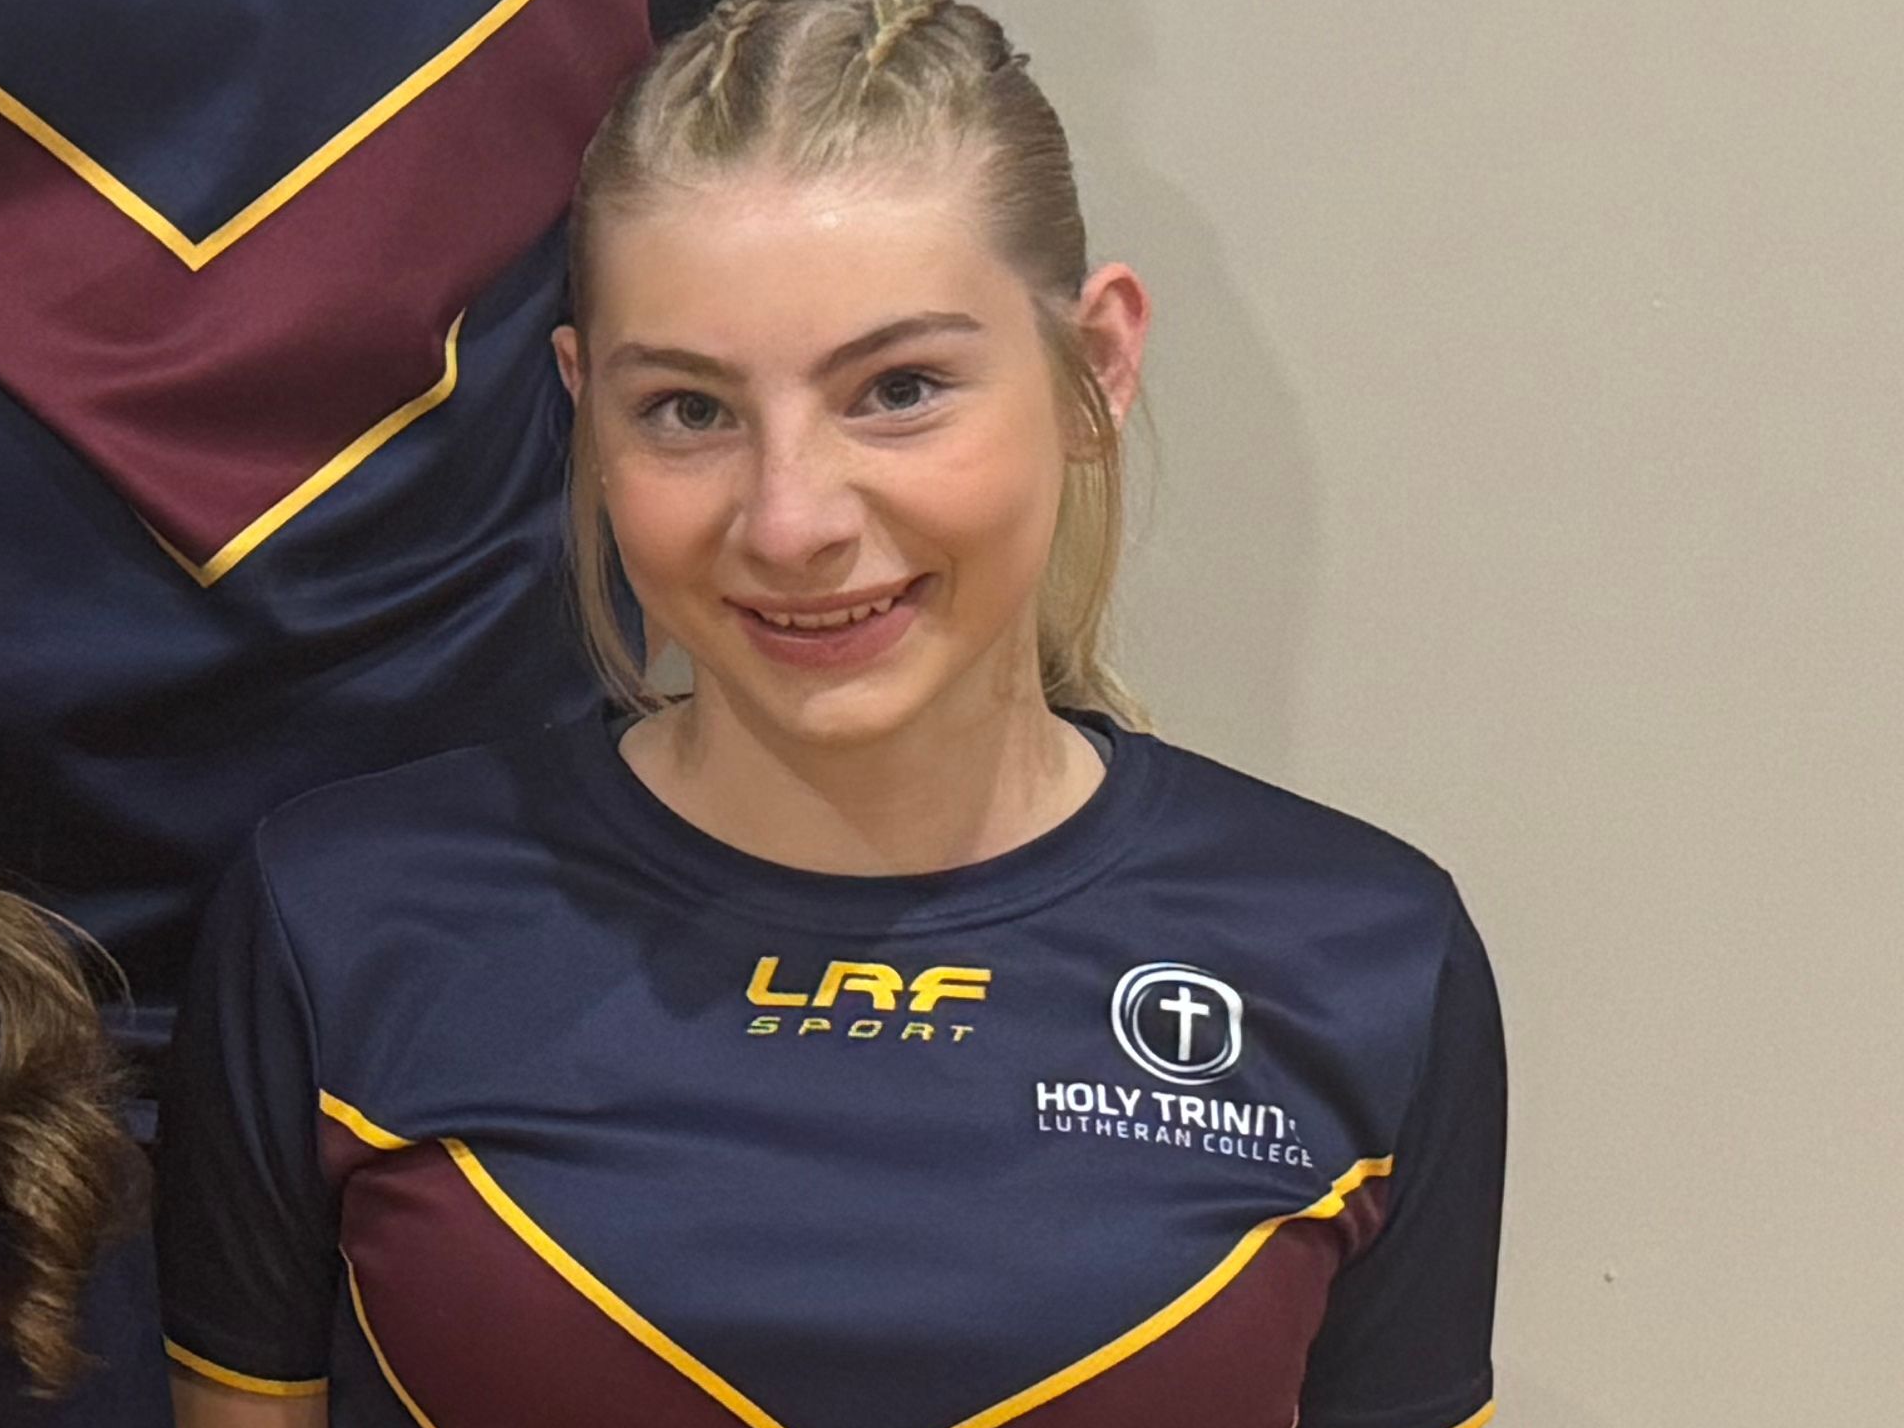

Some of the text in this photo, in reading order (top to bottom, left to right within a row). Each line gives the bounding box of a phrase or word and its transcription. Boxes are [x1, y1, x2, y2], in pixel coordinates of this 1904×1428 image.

[745, 956, 992, 1013] LRF
[745, 1015, 975, 1043] SPORT
[1035, 1081, 1302, 1140] HOLY TRINIT
[1038, 1113, 1314, 1168] LUTHERAN COLLEGE
